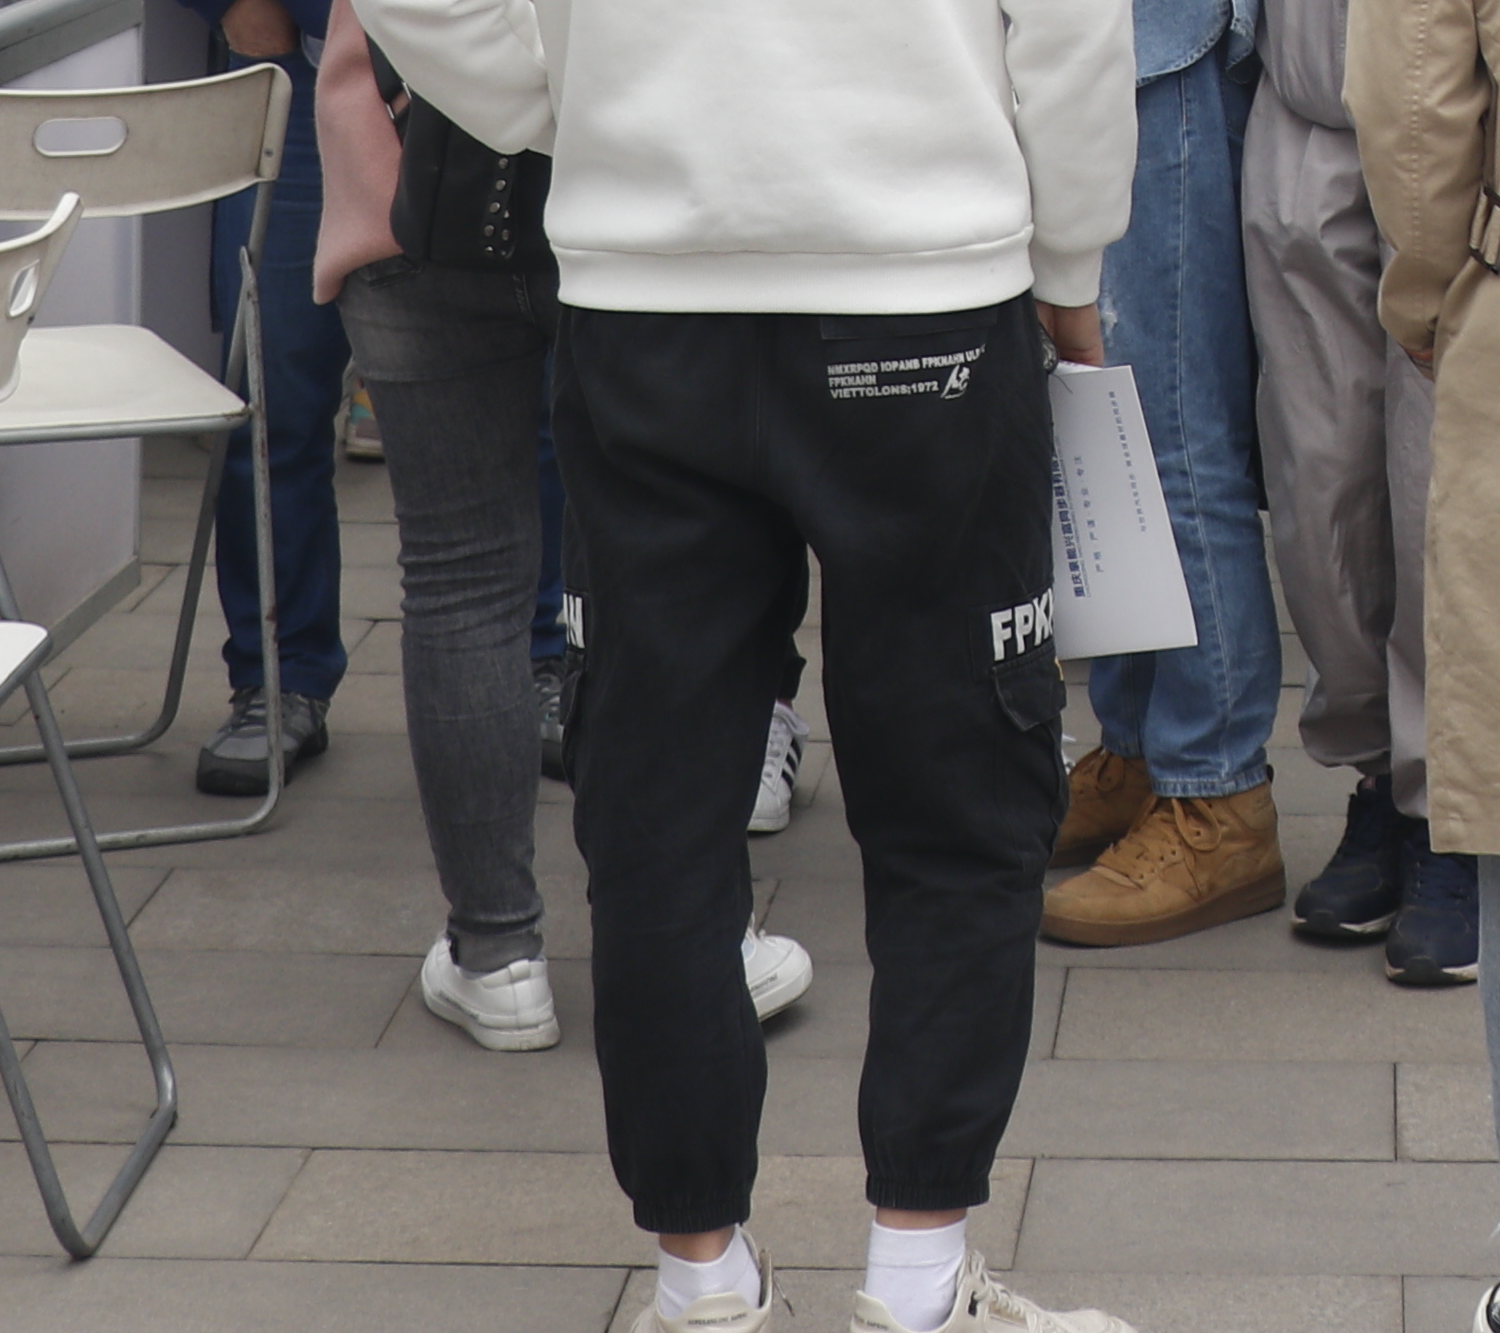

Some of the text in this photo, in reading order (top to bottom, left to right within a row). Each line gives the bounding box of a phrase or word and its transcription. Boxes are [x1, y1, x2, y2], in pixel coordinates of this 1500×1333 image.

[1051, 454, 1085, 598] 重庆豪能兴富同步器有限
